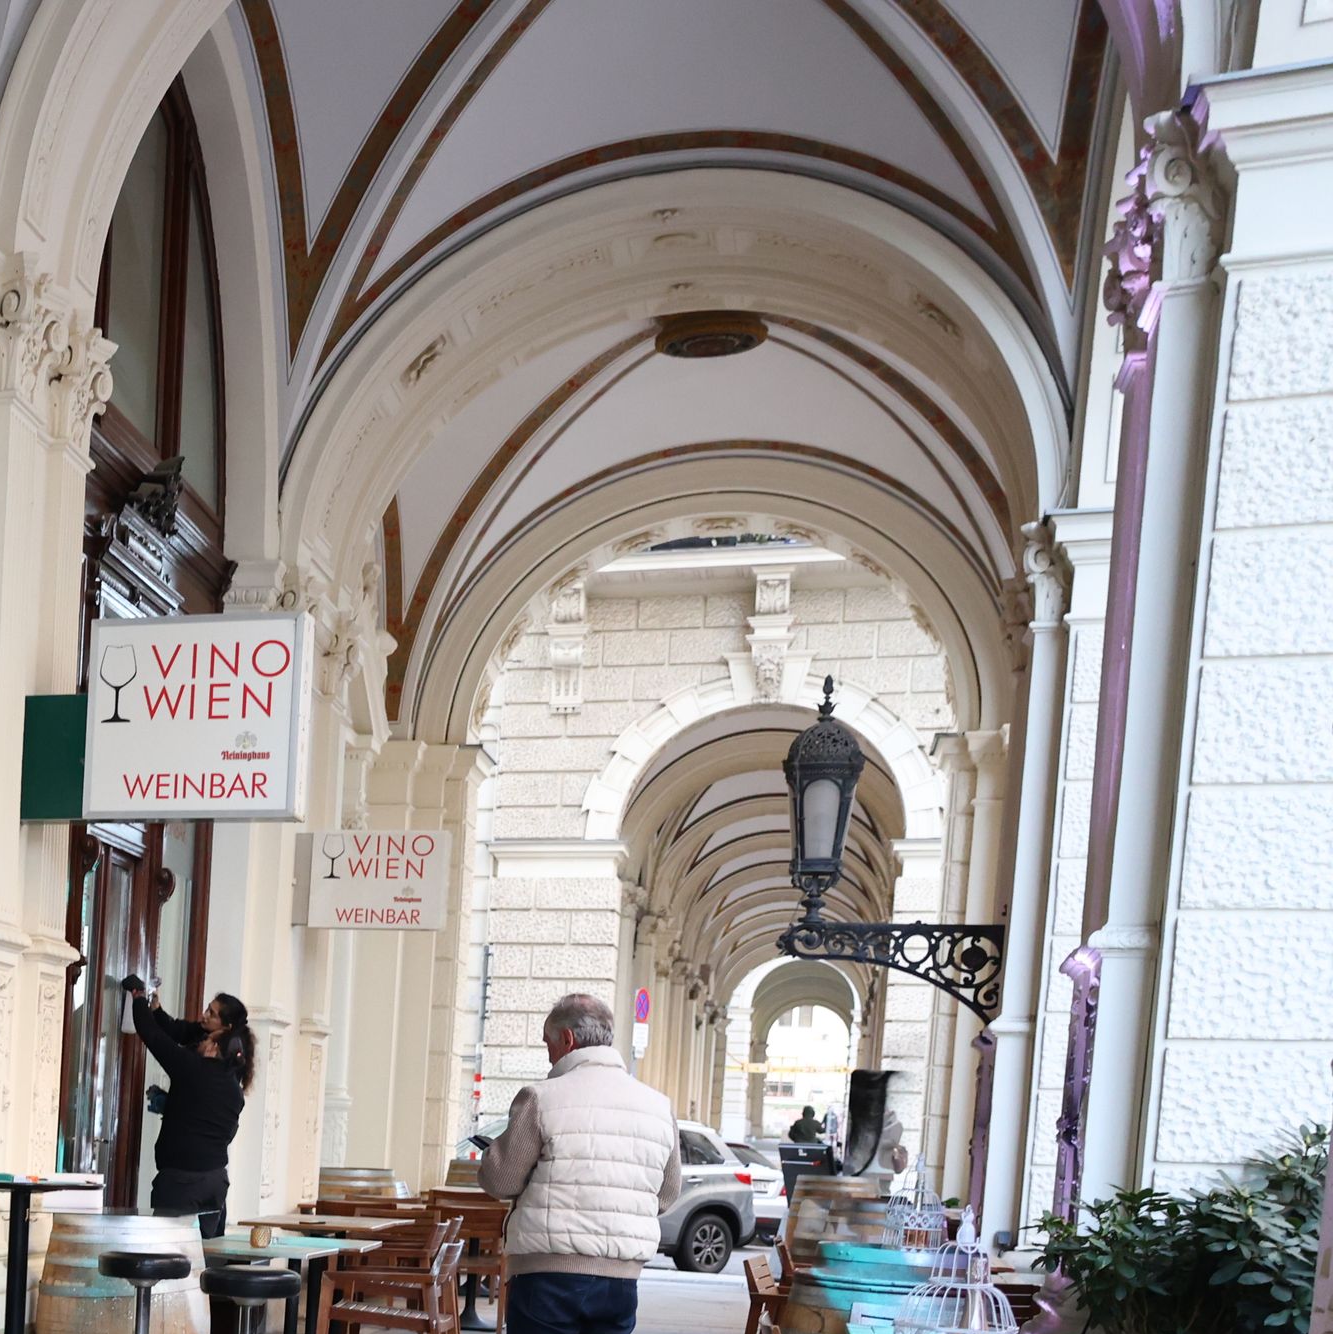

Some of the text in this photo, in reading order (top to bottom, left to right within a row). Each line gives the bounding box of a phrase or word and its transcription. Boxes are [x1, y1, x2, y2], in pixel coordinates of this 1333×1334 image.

[151, 639, 291, 680] VINO
[143, 681, 273, 721] WIEN
[122, 772, 268, 800] WEINBAR
[353, 834, 435, 857] VINO
[348, 857, 425, 879] WIEN
[335, 907, 421, 925] WEINBAR
